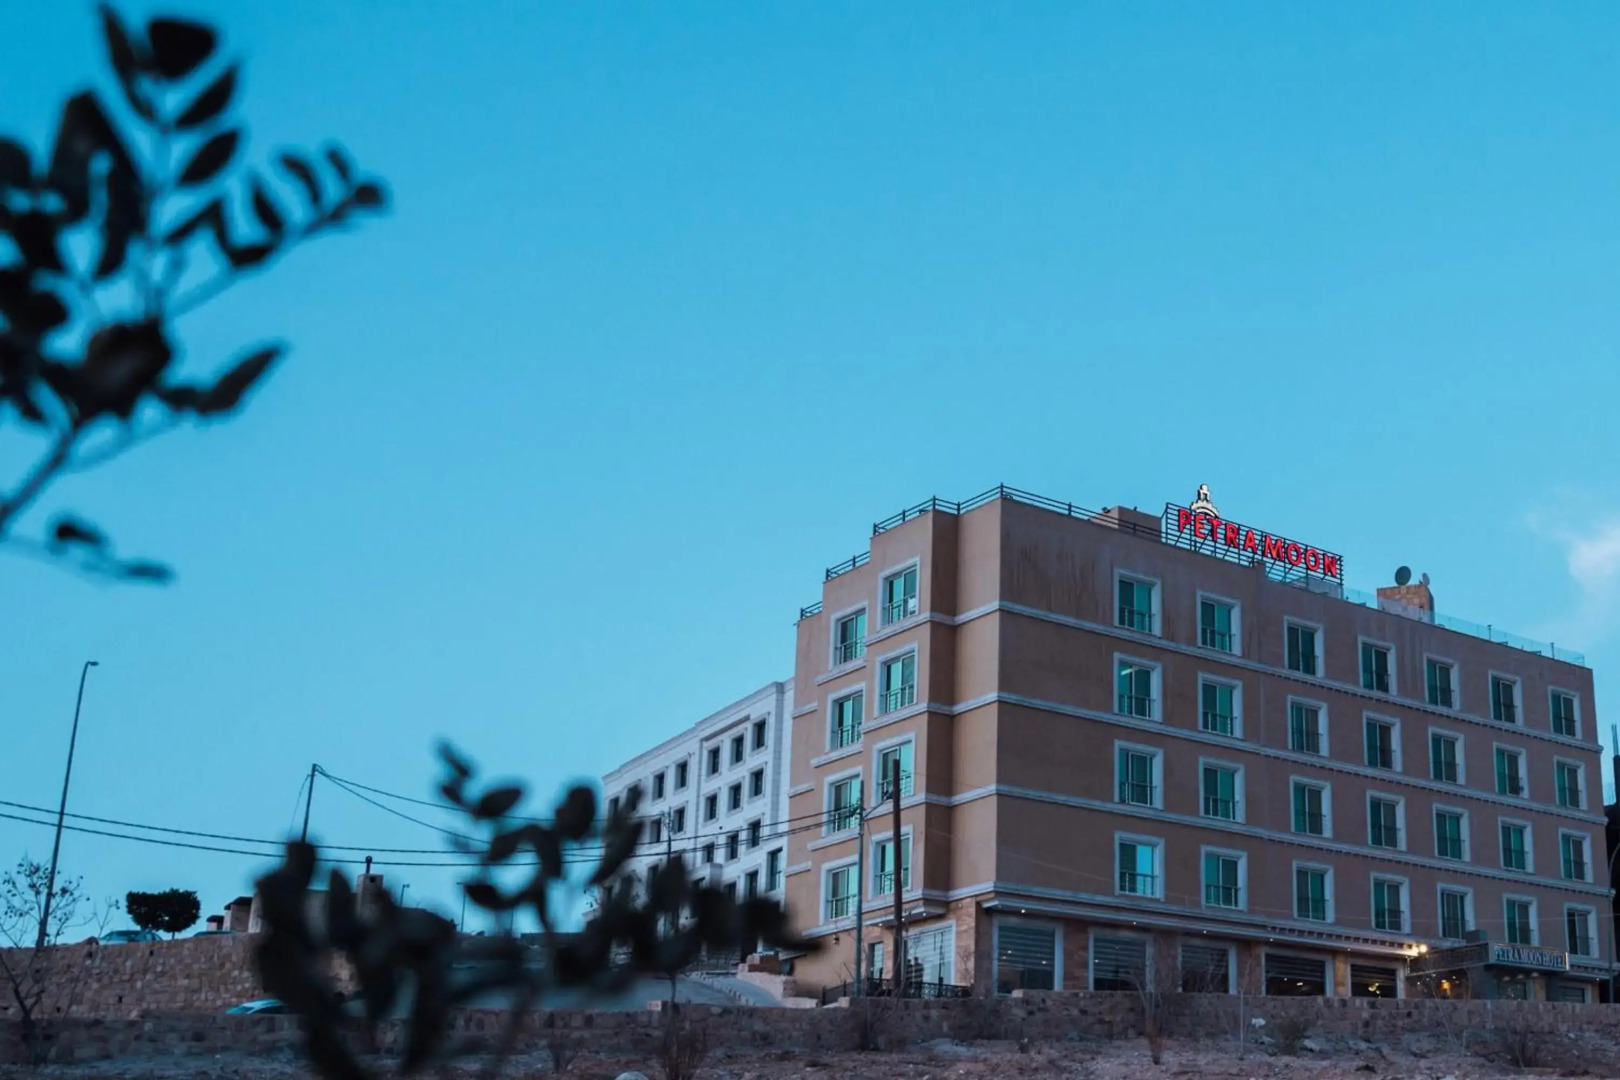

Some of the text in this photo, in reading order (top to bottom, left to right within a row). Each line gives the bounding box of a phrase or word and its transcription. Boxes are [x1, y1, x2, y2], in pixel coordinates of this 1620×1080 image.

[1178, 508, 1338, 578] PETRA MOON
[1495, 946, 1565, 967] PETRA MOON HOTEL
